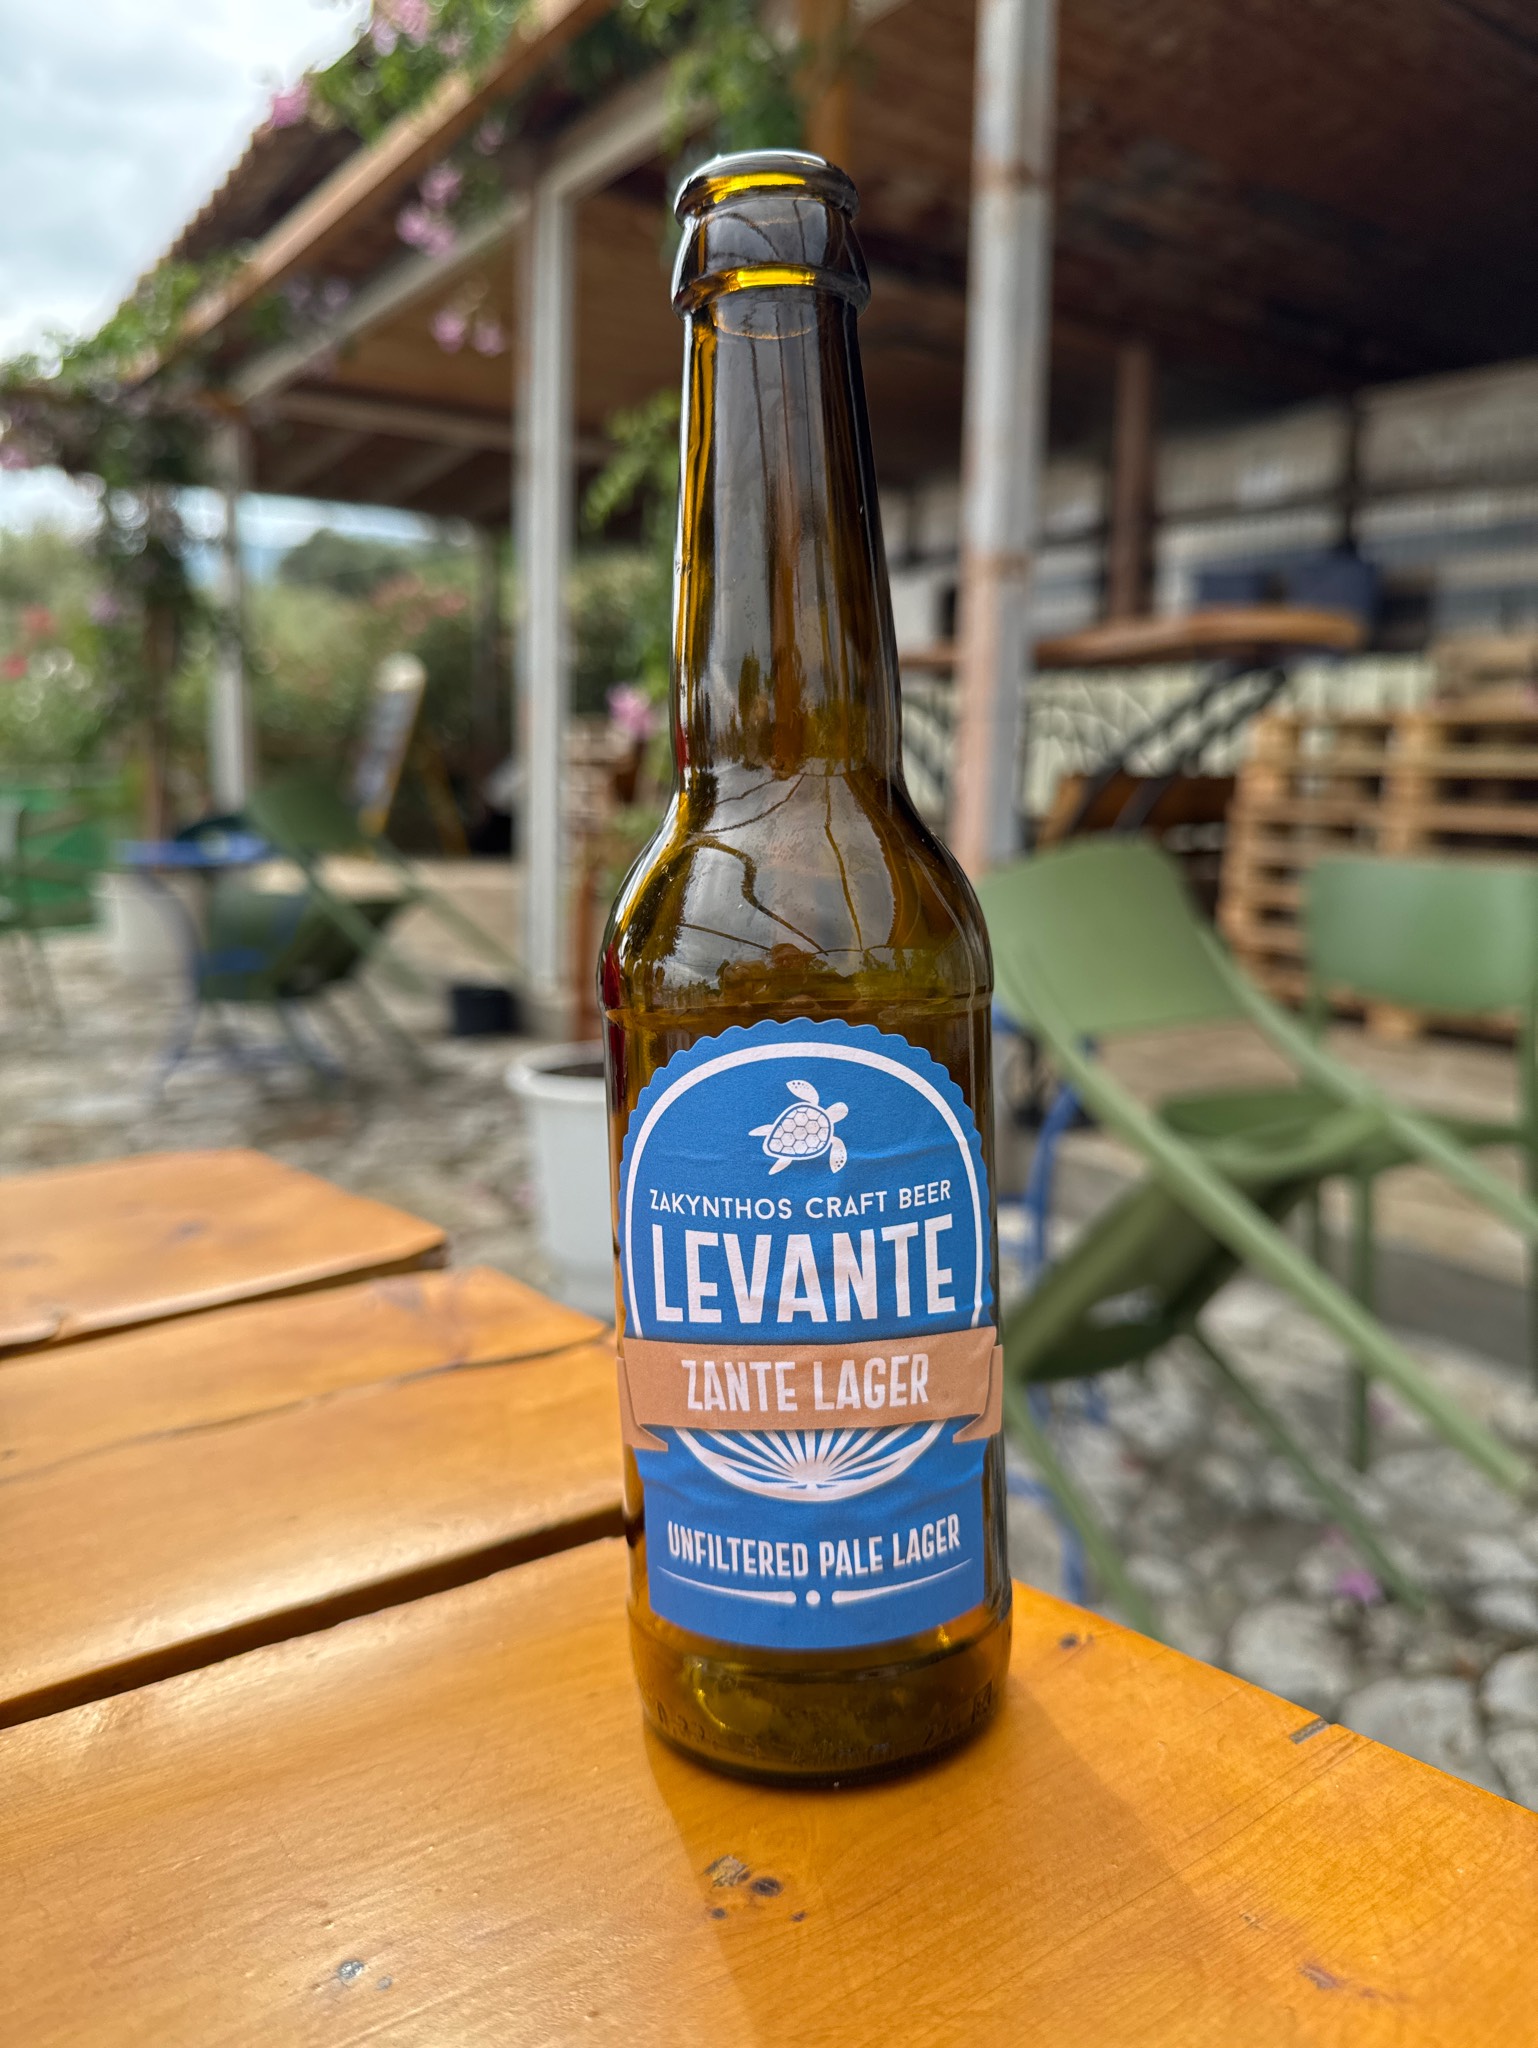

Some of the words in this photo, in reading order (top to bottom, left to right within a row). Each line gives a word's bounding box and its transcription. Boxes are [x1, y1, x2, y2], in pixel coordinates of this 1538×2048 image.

[649, 1188, 792, 1220] ZAKYNTHOS
[805, 1189, 888, 1220] CRAFT
[899, 1179, 951, 1210] BEER
[652, 1213, 957, 1324] LEVANTE
[681, 1358, 798, 1412] ZANTE
[813, 1352, 929, 1410] LAGER
[667, 1520, 809, 1577] UNFILTERED
[818, 1535, 883, 1577] PALE
[892, 1512, 961, 1567] LAGER
